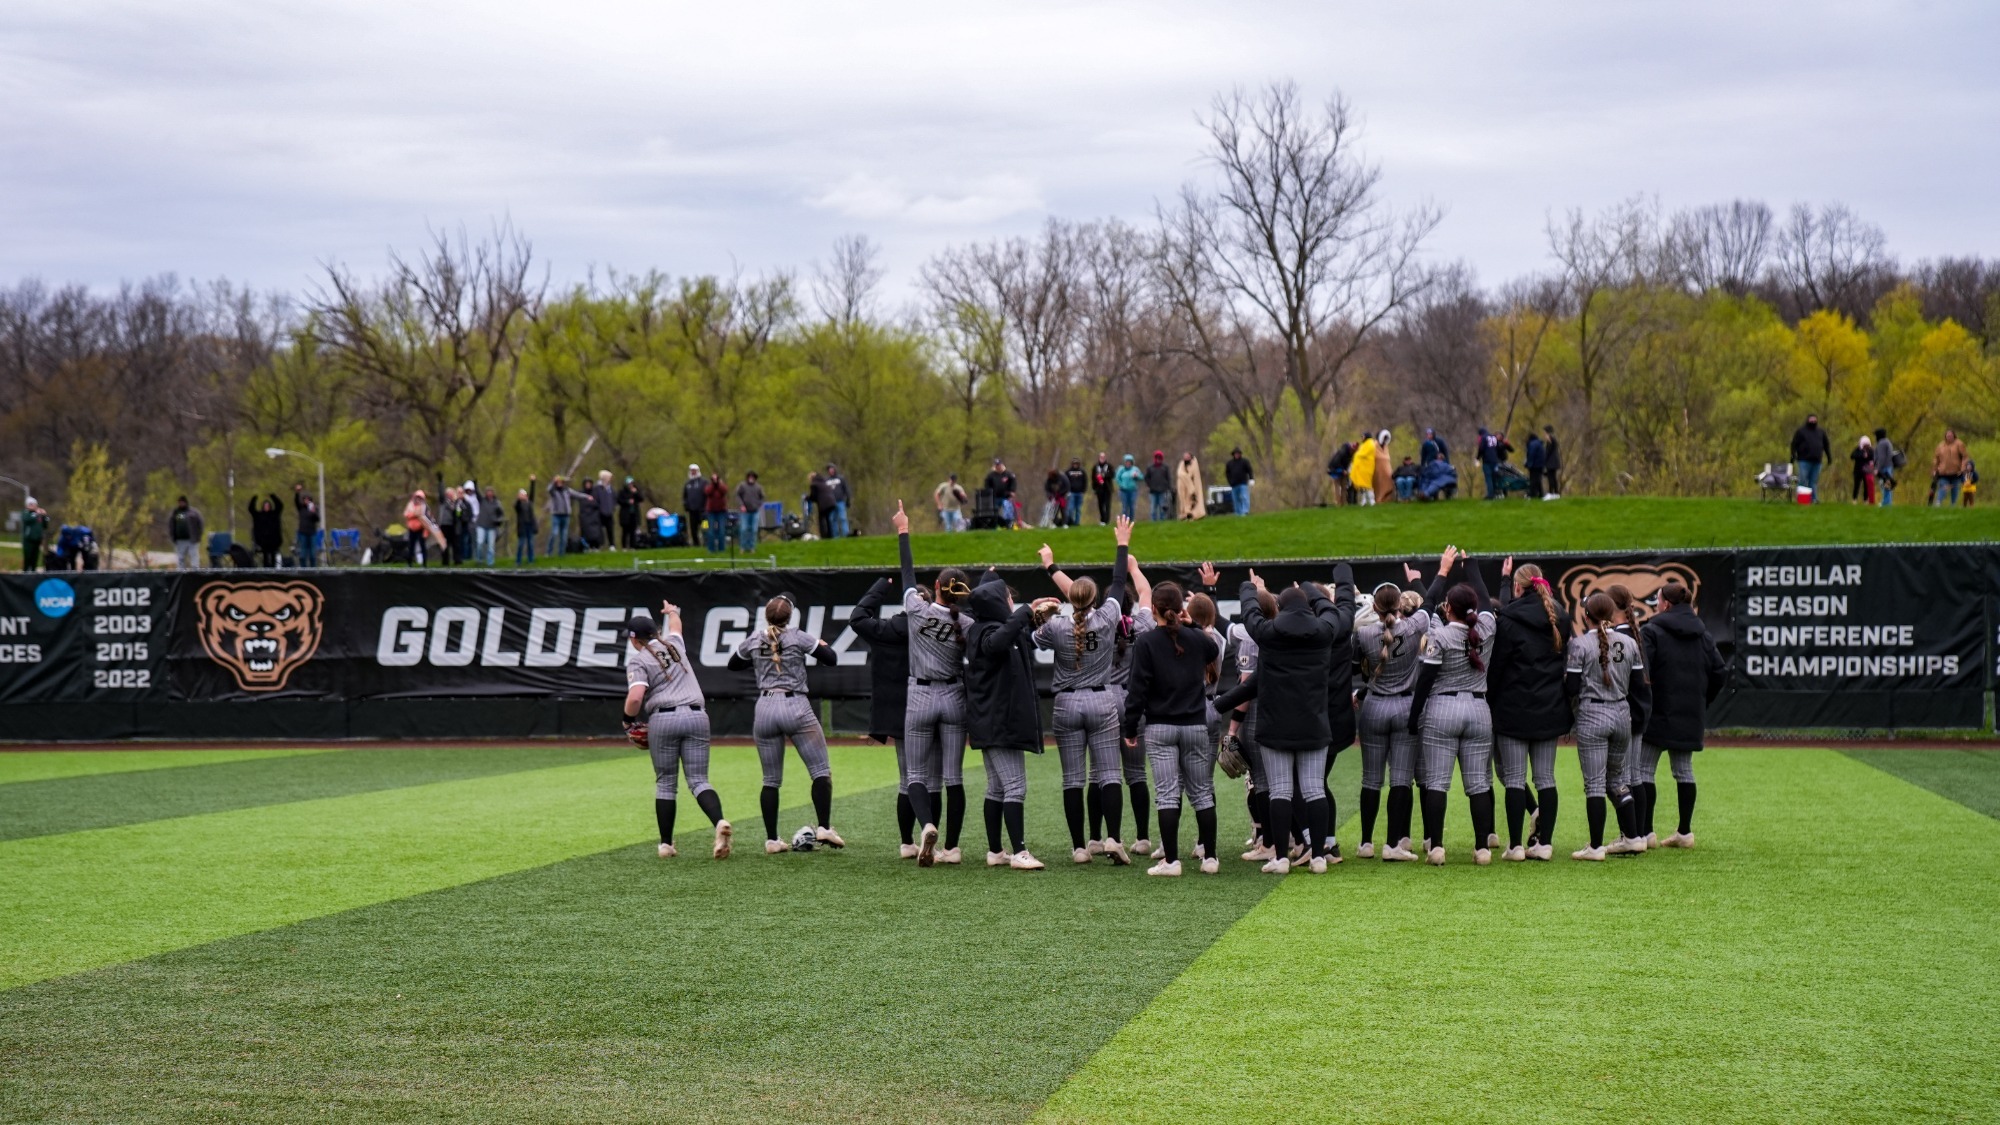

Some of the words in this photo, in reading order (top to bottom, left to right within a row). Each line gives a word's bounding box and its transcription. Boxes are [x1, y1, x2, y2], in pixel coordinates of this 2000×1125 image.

[1747, 565, 1862, 587] REGULAR
[39, 596, 74, 608] NCAA
[93, 587, 151, 607] 2002
[1747, 595, 1848, 617] SEASON
[0, 616, 31, 636] NT
[93, 614, 151, 634] 2003
[919, 617, 954, 642] 20
[1746, 625, 1914, 647] CONFERENCE
[0, 644, 42, 663] CES
[96, 642, 149, 661] 2015
[1746, 655, 1960, 677] CHAMPIONSHIPS
[93, 669, 151, 688] 2022
